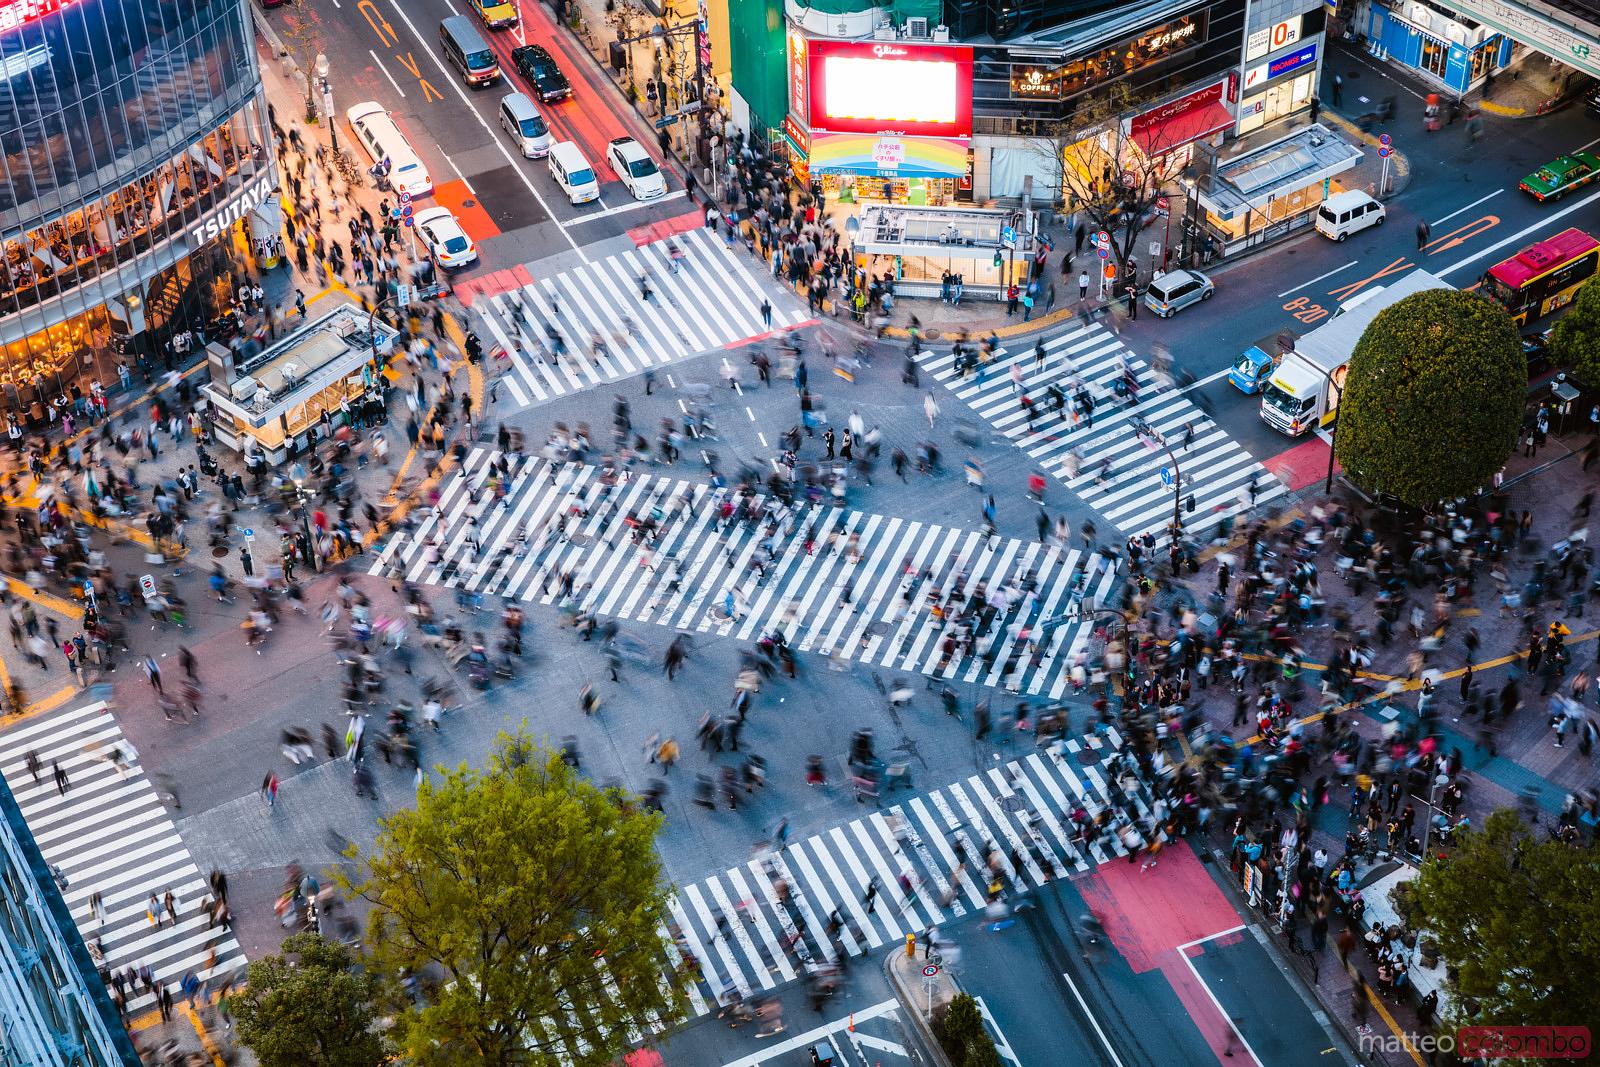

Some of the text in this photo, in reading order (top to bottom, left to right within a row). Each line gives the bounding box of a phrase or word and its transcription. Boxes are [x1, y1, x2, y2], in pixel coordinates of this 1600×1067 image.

[873, 45, 908, 58] Glico
[1571, 44, 1590, 60] JR
[1271, 56, 1299, 72] PROMISE
[192, 177, 272, 246] TSUTAYA
[1282, 296, 1329, 324] 8-20
